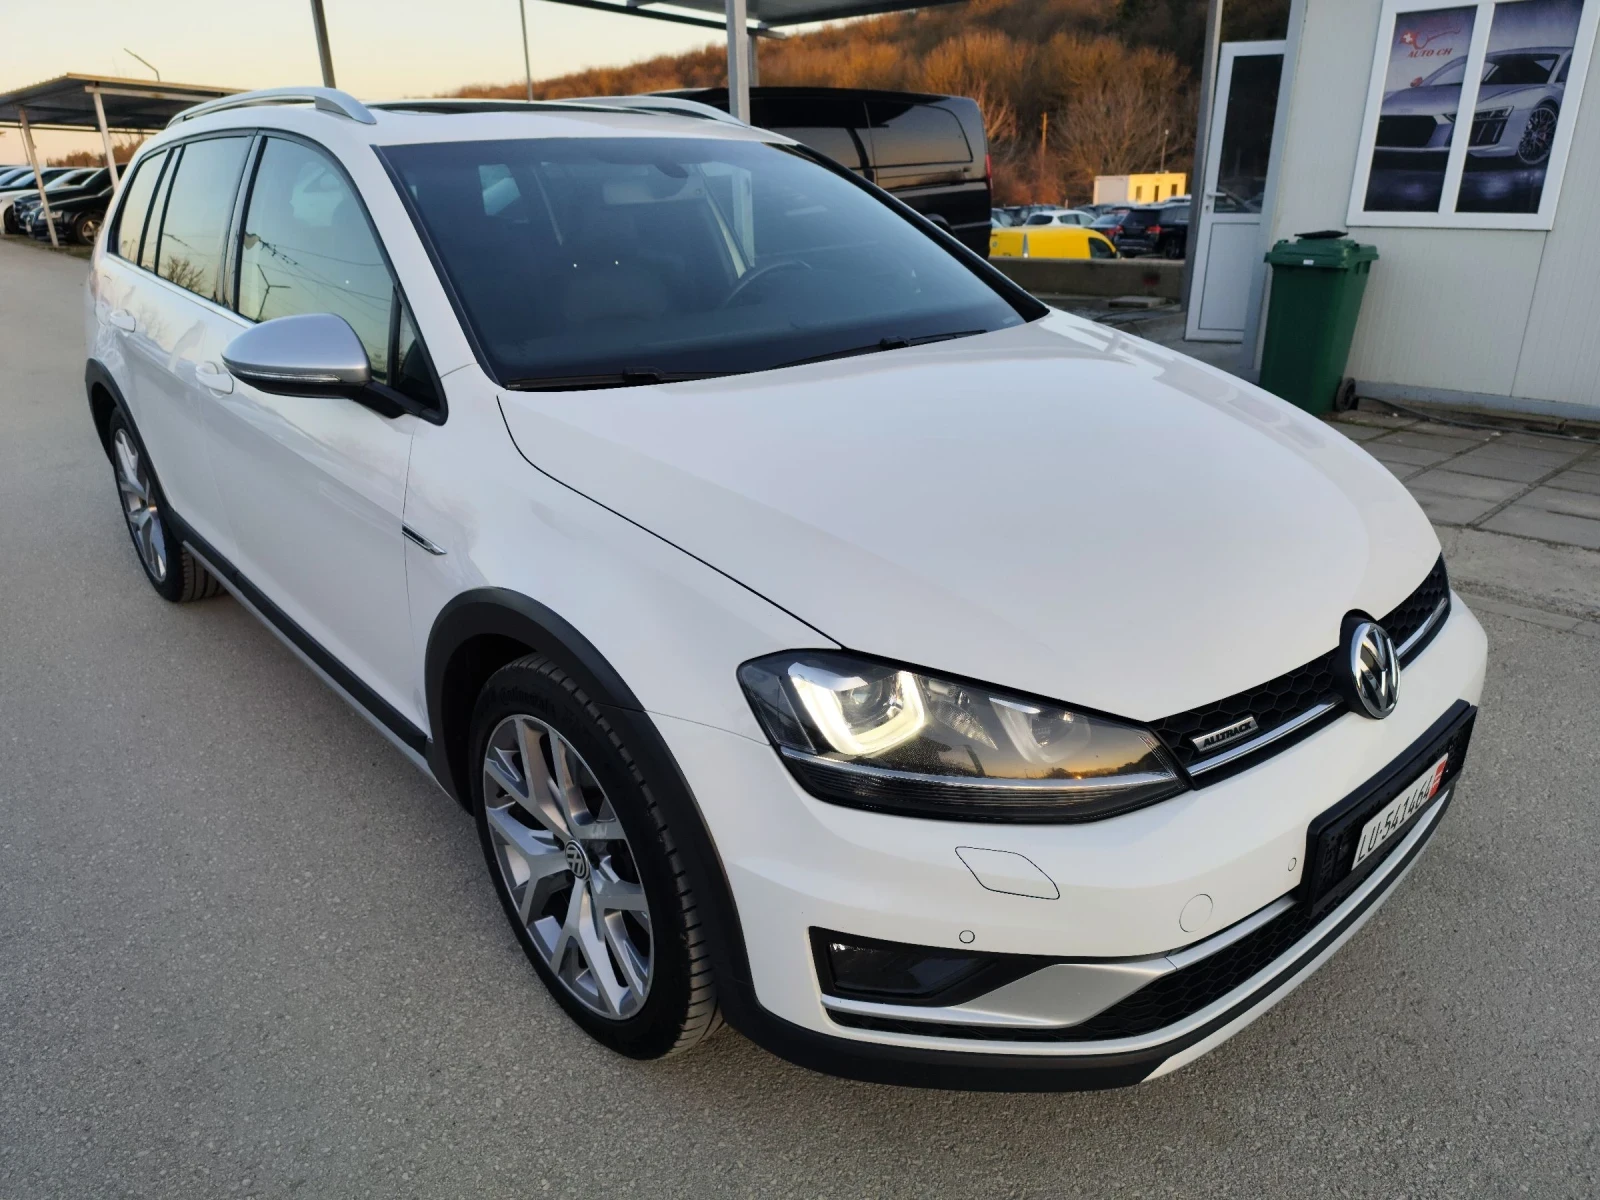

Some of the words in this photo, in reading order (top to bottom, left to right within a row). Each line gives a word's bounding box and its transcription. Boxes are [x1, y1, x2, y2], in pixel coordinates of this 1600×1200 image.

[1408, 49, 1434, 58] AUTO
[1437, 48, 1453, 57] CH
[1203, 722, 1253, 748] ALLTRACK
